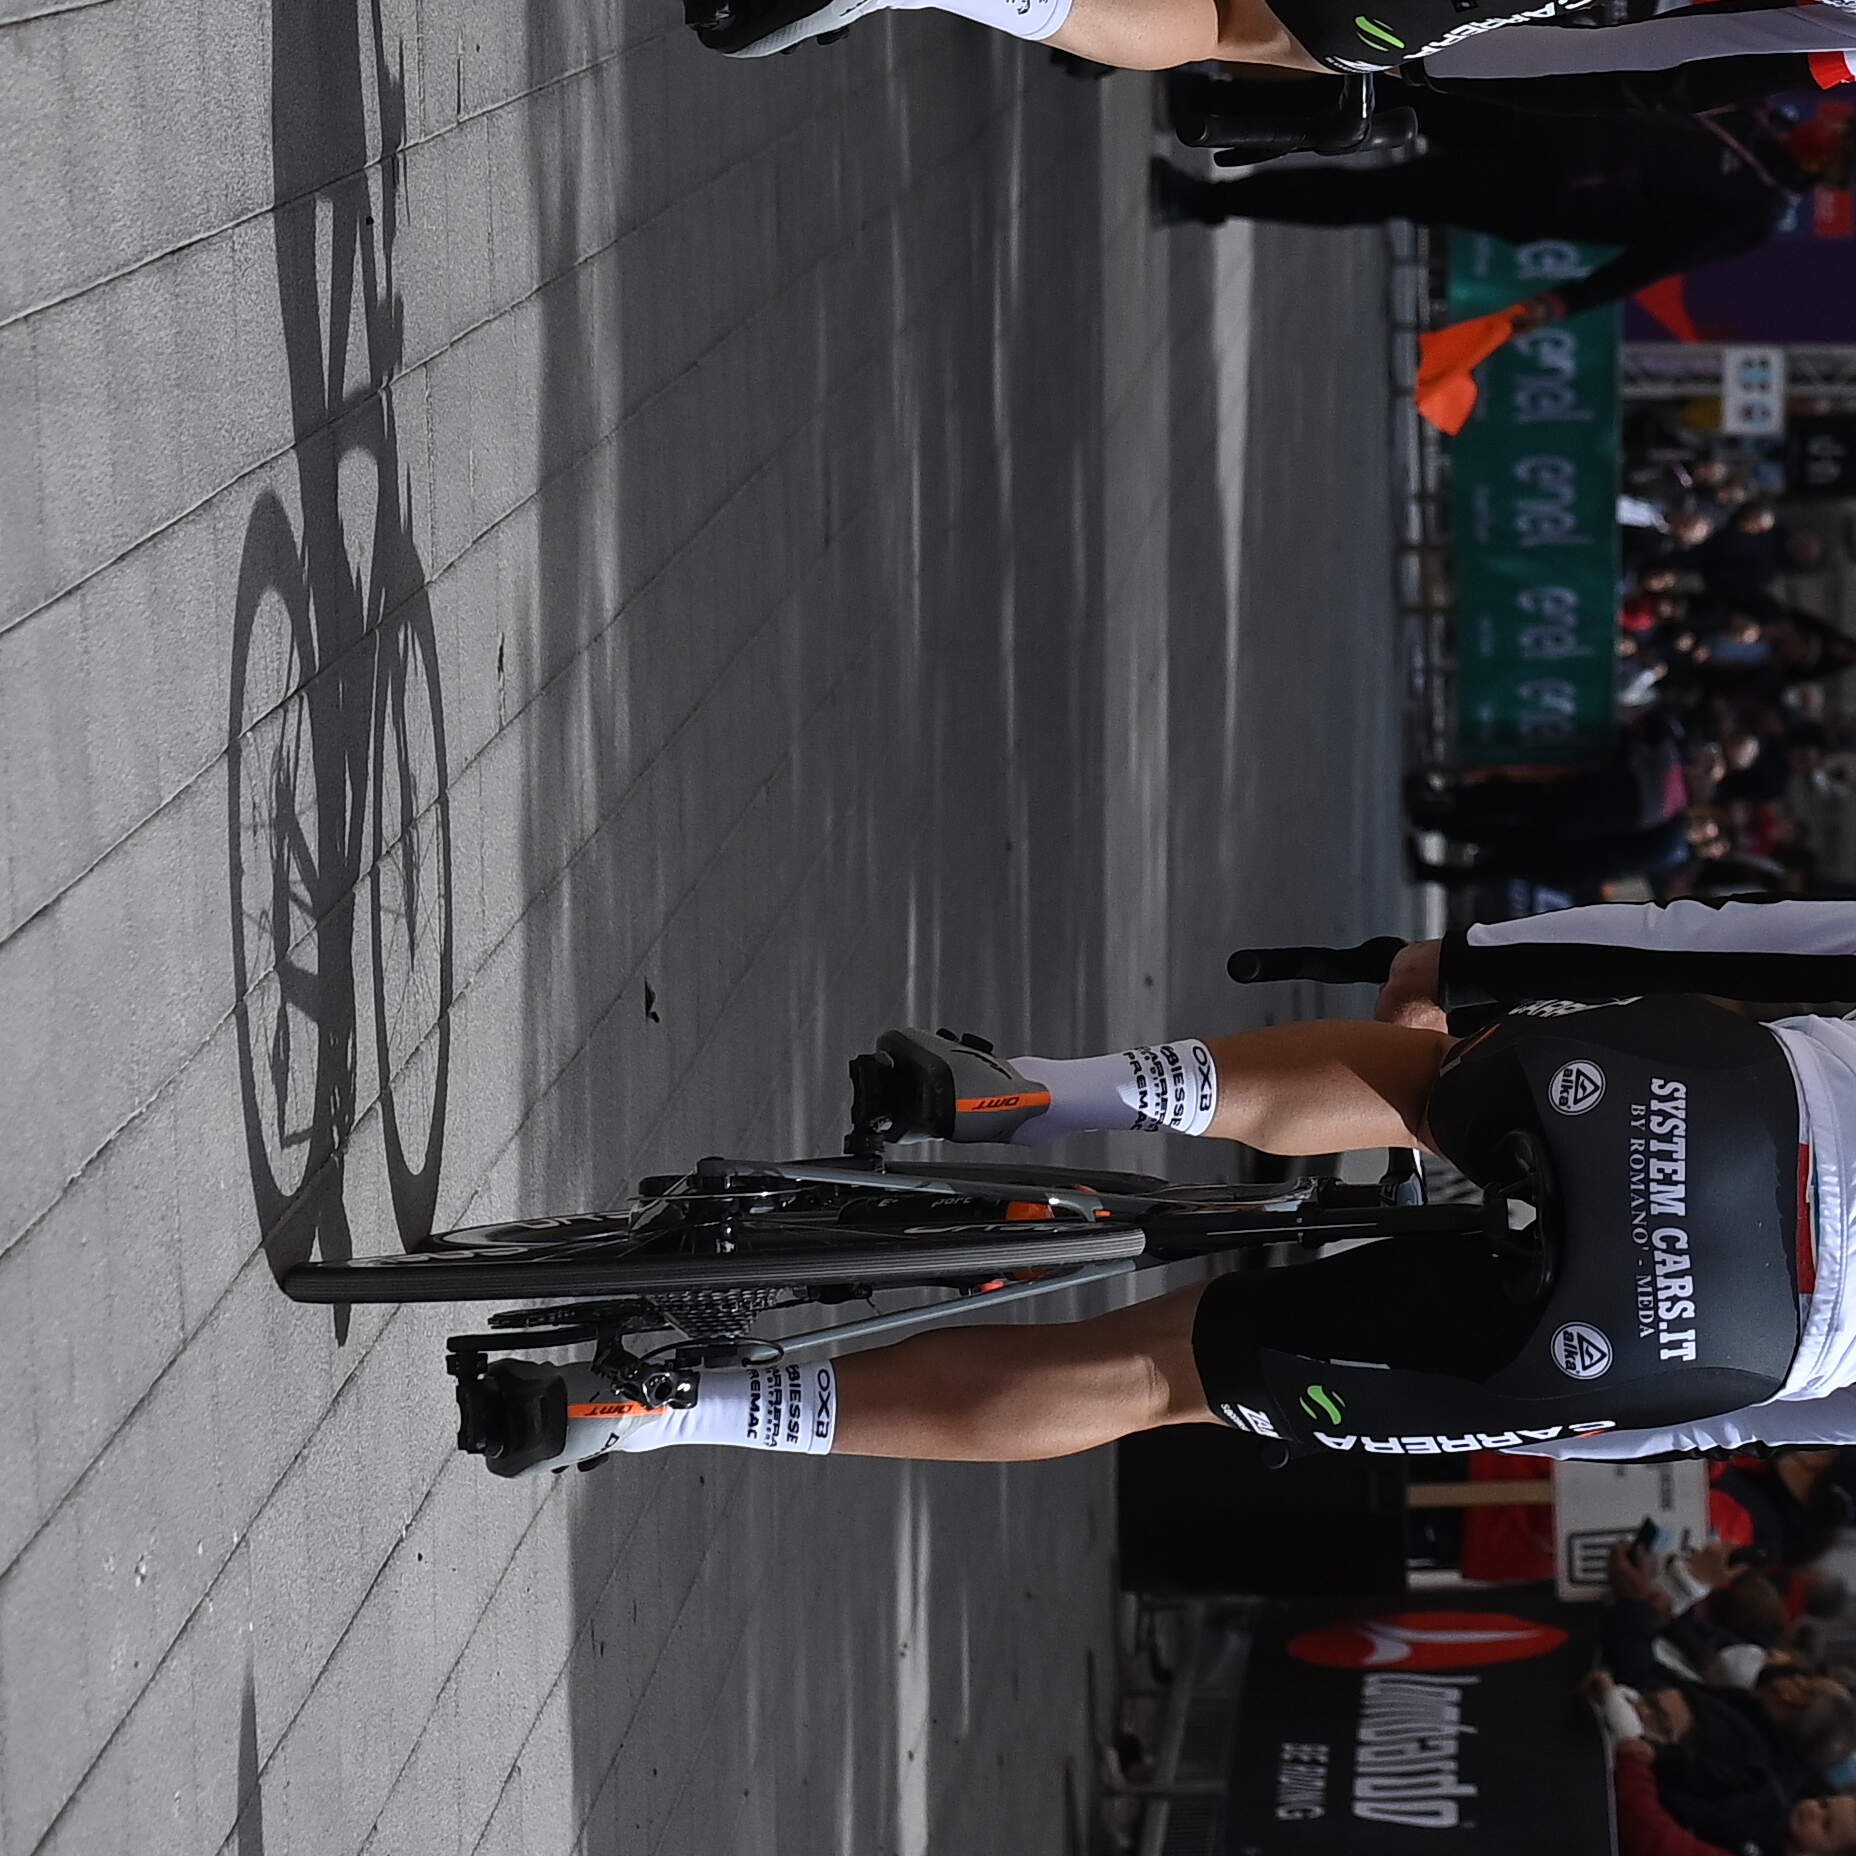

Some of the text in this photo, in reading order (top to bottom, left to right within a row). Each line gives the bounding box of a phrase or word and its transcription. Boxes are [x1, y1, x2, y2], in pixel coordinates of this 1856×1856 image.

[1515, 453, 1594, 545] enel
[1192, 1046, 1212, 1112] OXB
[1630, 1103, 1648, 1132] BY
[1649, 1077, 1696, 1362] SYSTEM CARS.IT
[1635, 1274, 1656, 1339] MEDA
[745, 1368, 762, 1440] REMAC
[815, 1369, 831, 1439] OXB
[1312, 1419, 1617, 1453] CARRERA
